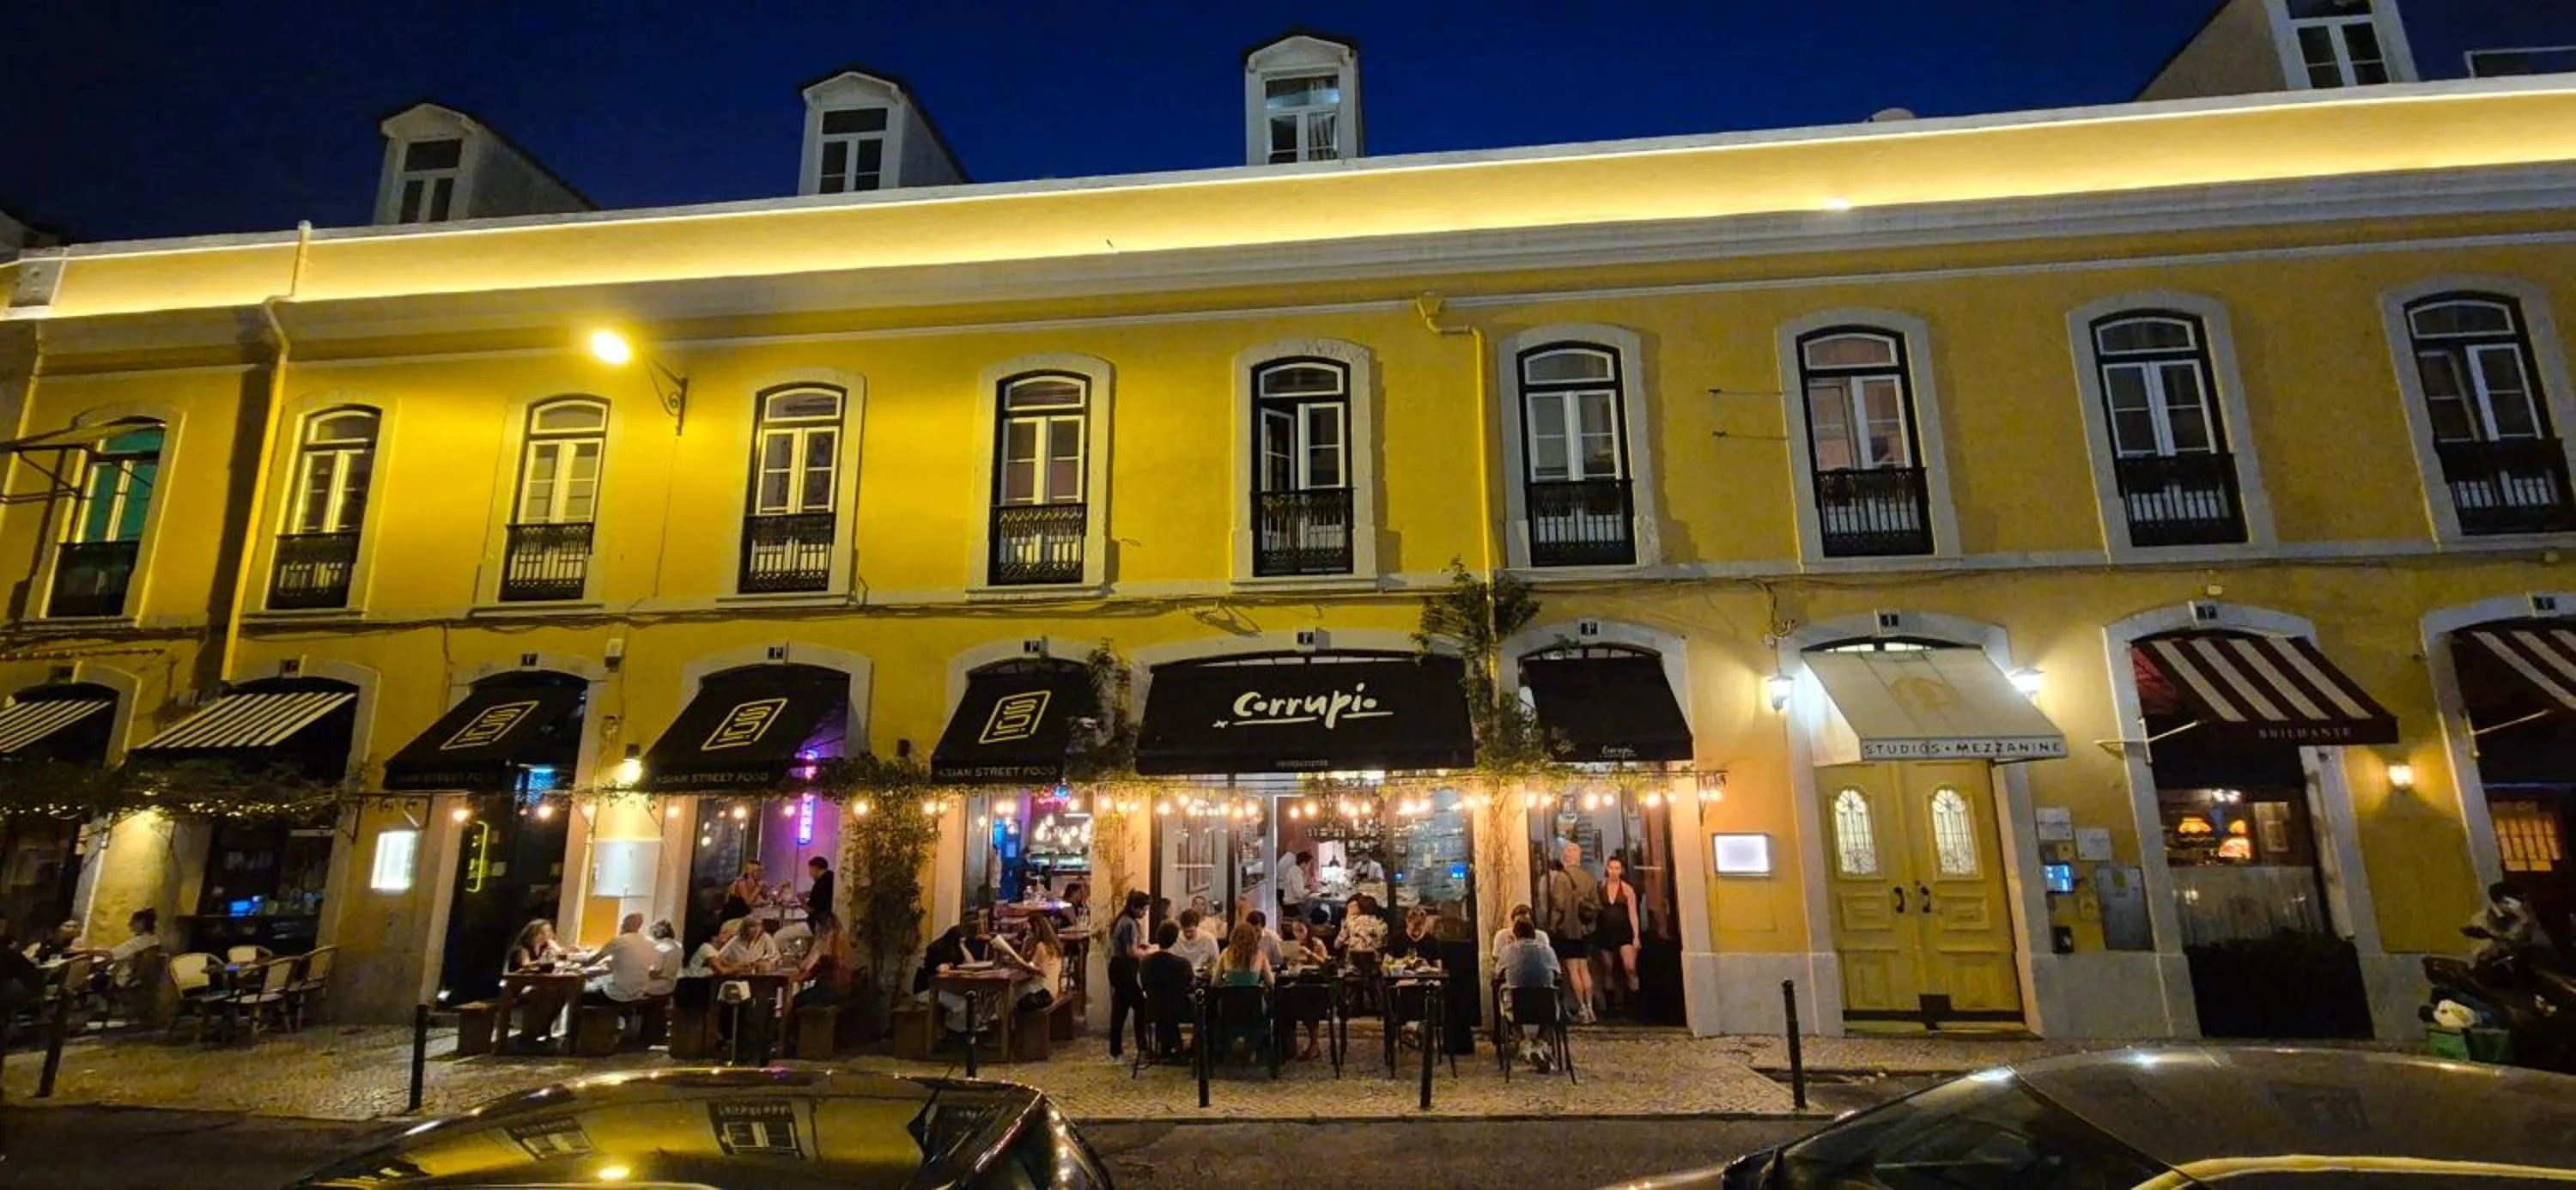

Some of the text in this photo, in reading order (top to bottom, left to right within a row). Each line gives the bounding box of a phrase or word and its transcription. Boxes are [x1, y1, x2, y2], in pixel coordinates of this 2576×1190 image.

[1233, 683, 1377, 729] Corrupio
[1864, 741, 2063, 755] STUDIOS MEZZANINE
[691, 772, 734, 784] STREET
[736, 771, 770, 782] FOOD
[975, 767, 1020, 777] STREET
[1023, 766, 1057, 776] FOOD
